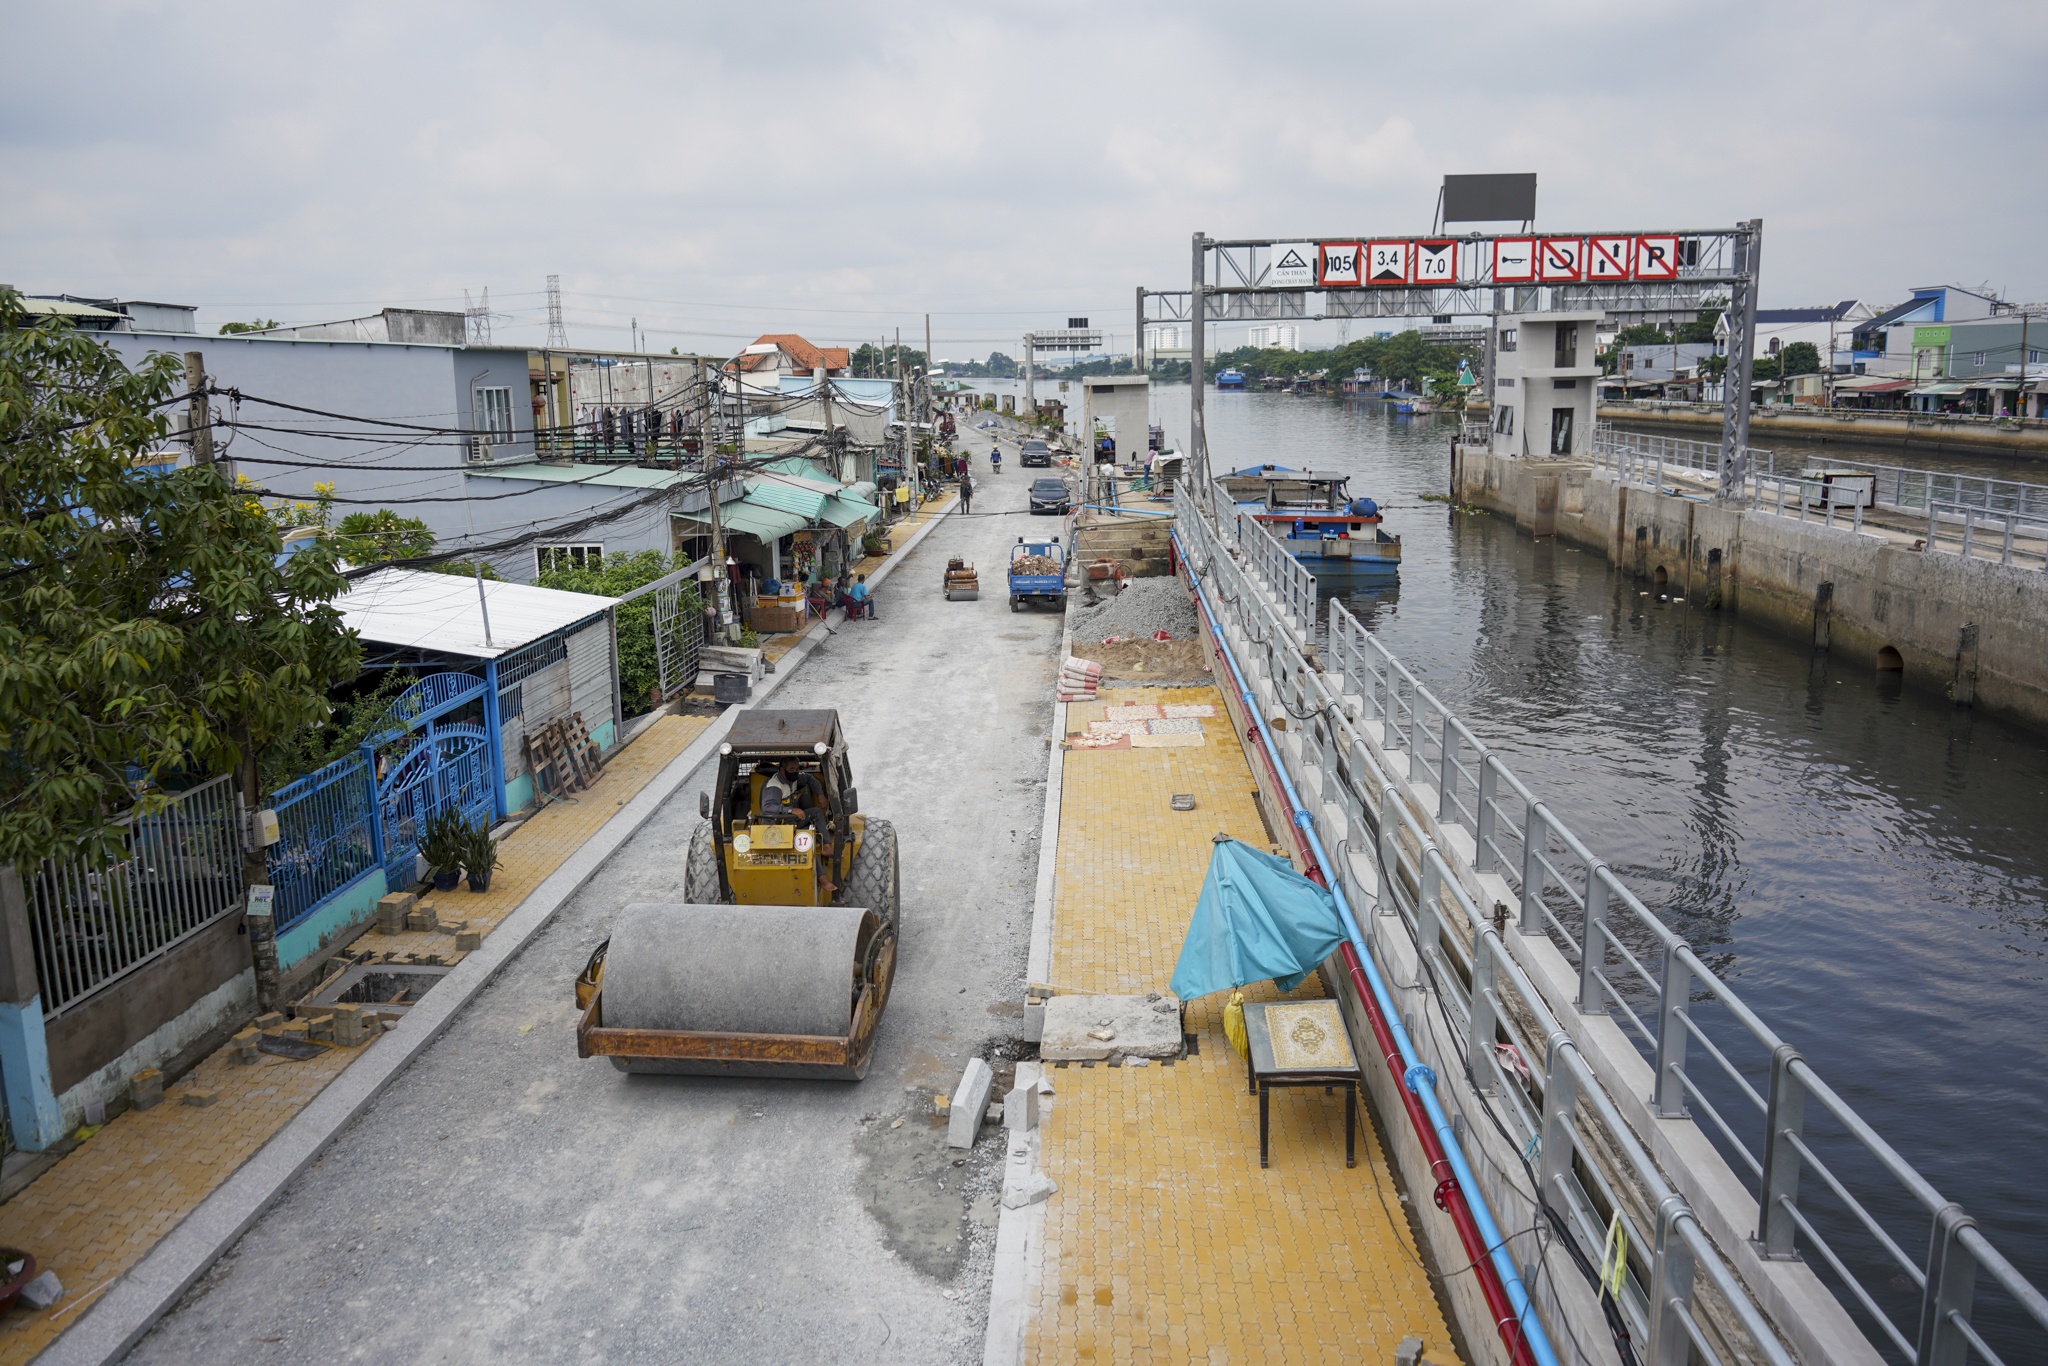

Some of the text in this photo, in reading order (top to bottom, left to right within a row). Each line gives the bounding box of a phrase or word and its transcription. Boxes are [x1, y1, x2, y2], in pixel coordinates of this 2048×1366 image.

[1329, 256, 1352, 273] 10.5
[1378, 251, 1399, 266] 3.4
[1648, 246, 1665, 268] P
[1425, 258, 1446, 274] 7.0
[798, 837, 809, 846] 17
